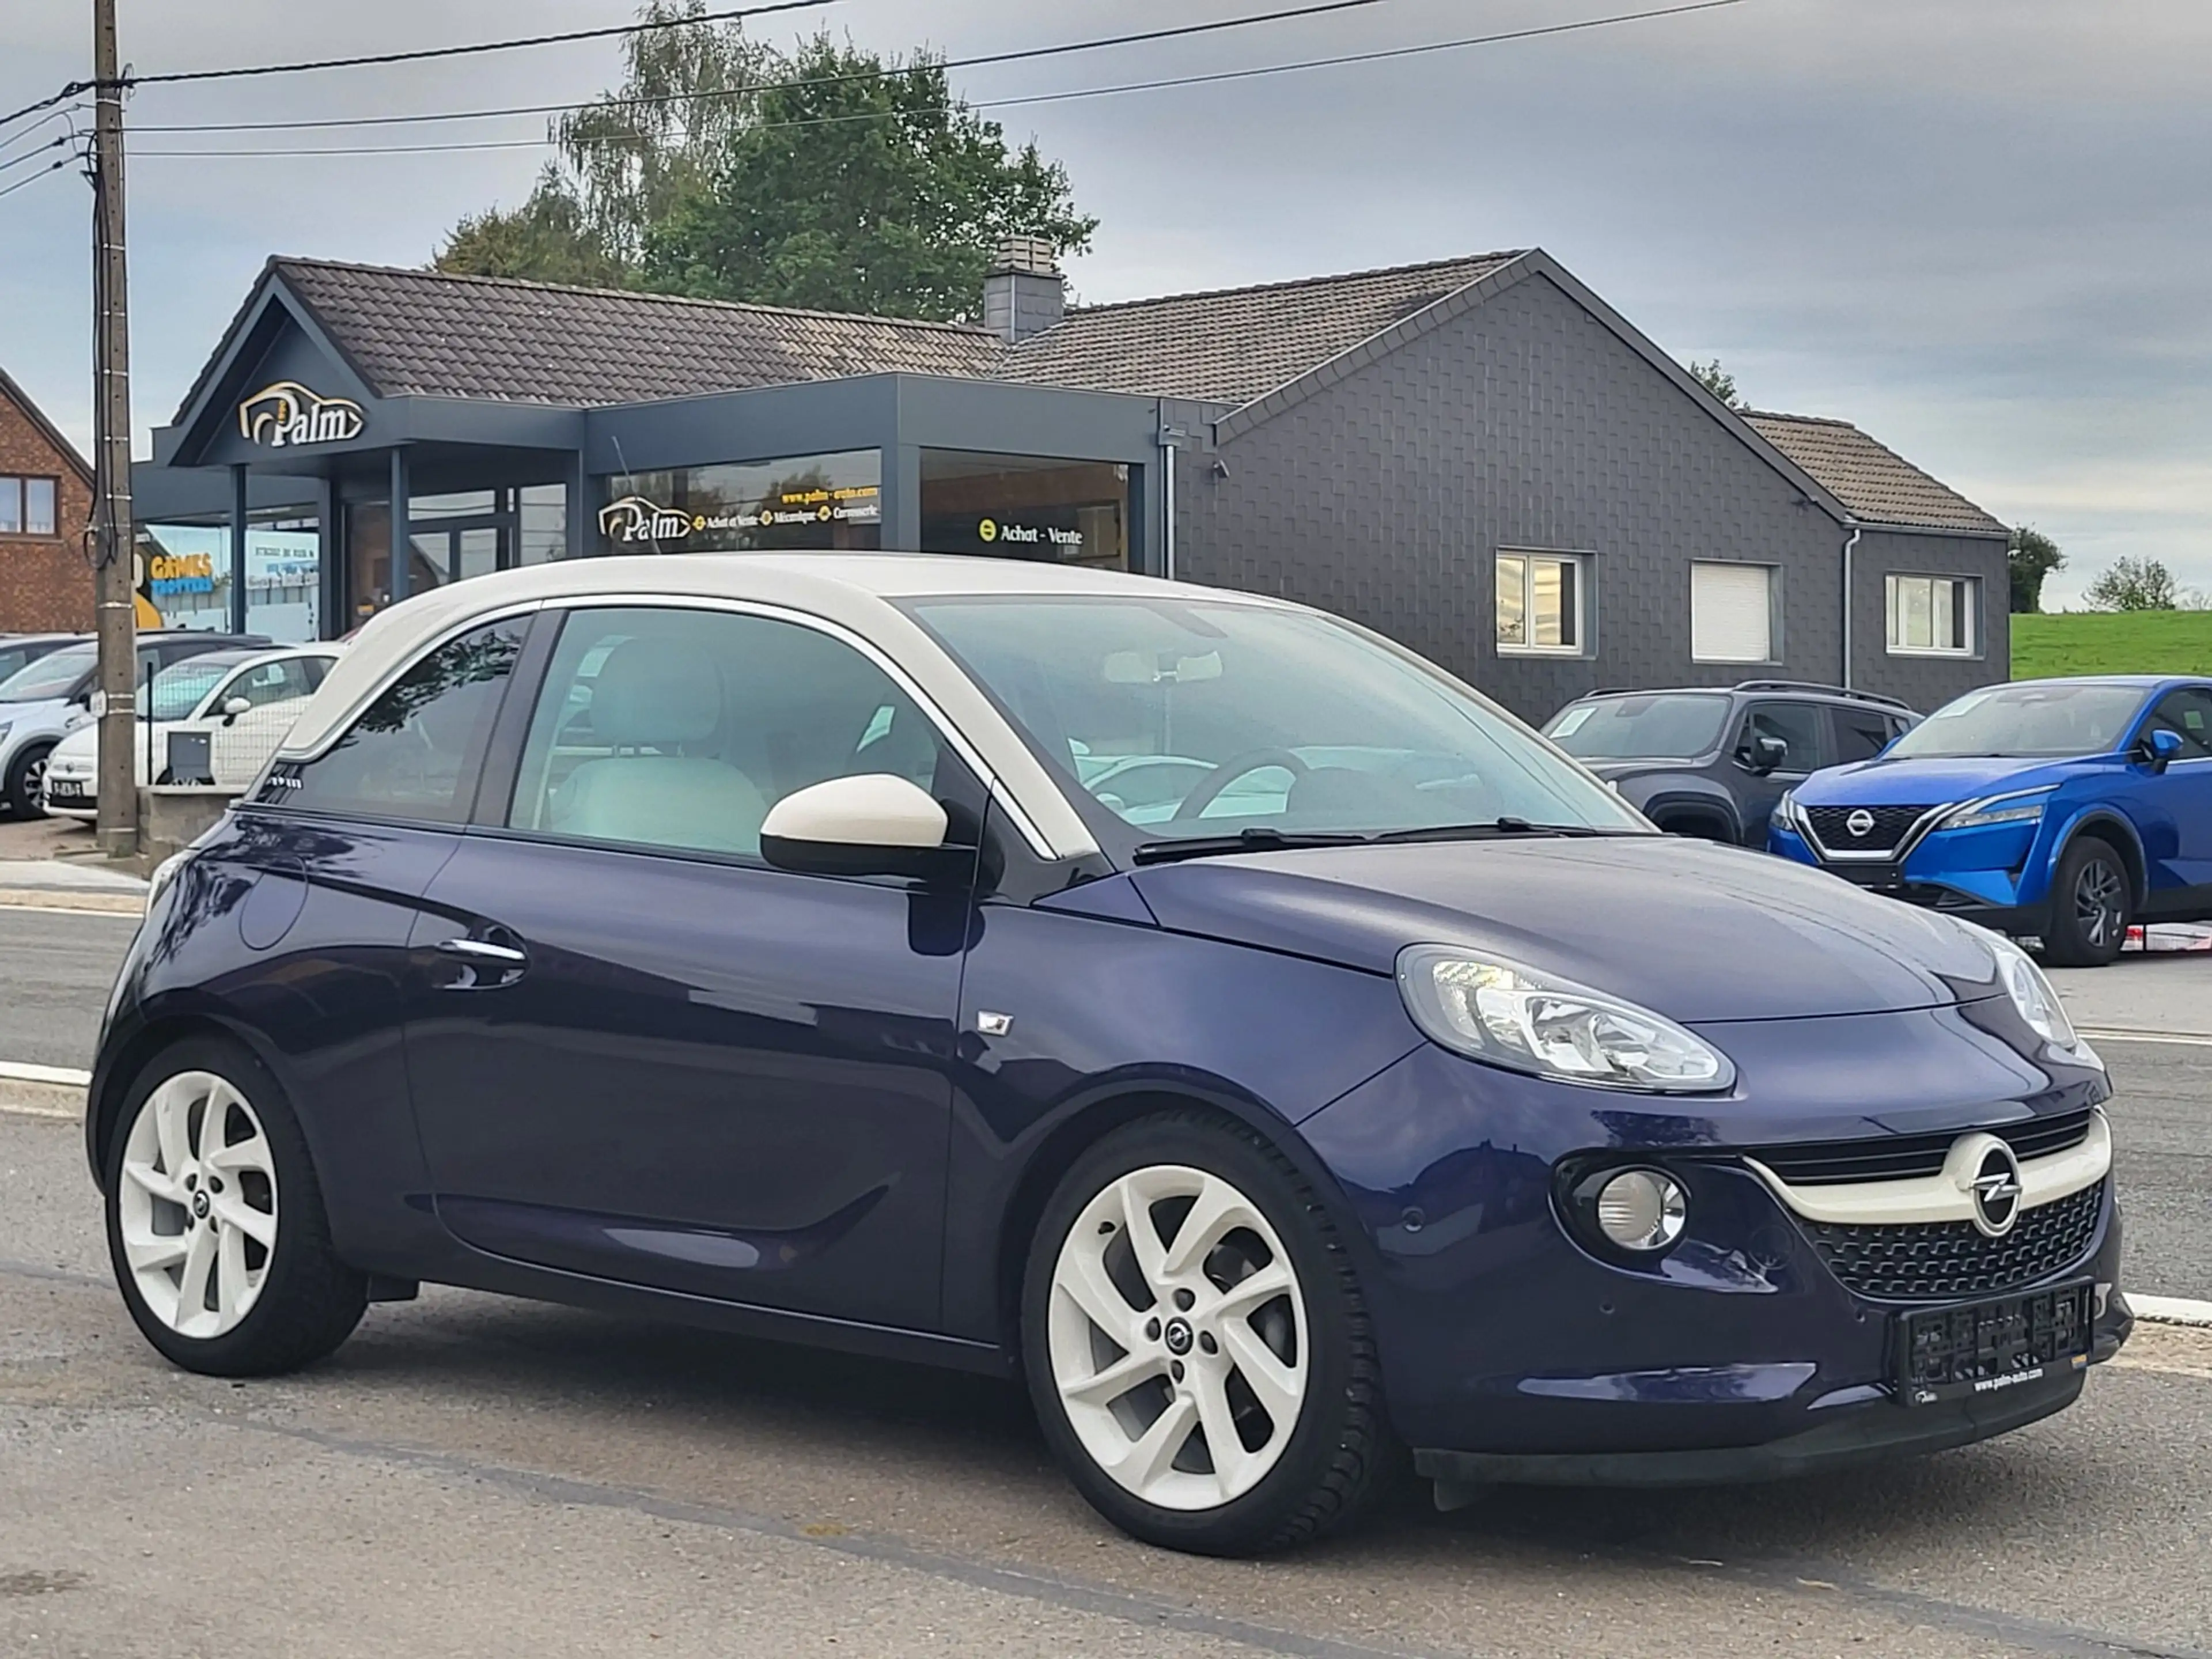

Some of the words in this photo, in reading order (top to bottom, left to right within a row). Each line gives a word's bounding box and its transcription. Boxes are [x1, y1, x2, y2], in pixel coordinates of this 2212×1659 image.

[271, 388, 347, 447] Palm
[622, 503, 679, 541] Palm
[1001, 525, 1038, 543] Achat
[1047, 527, 1083, 545] Vente
